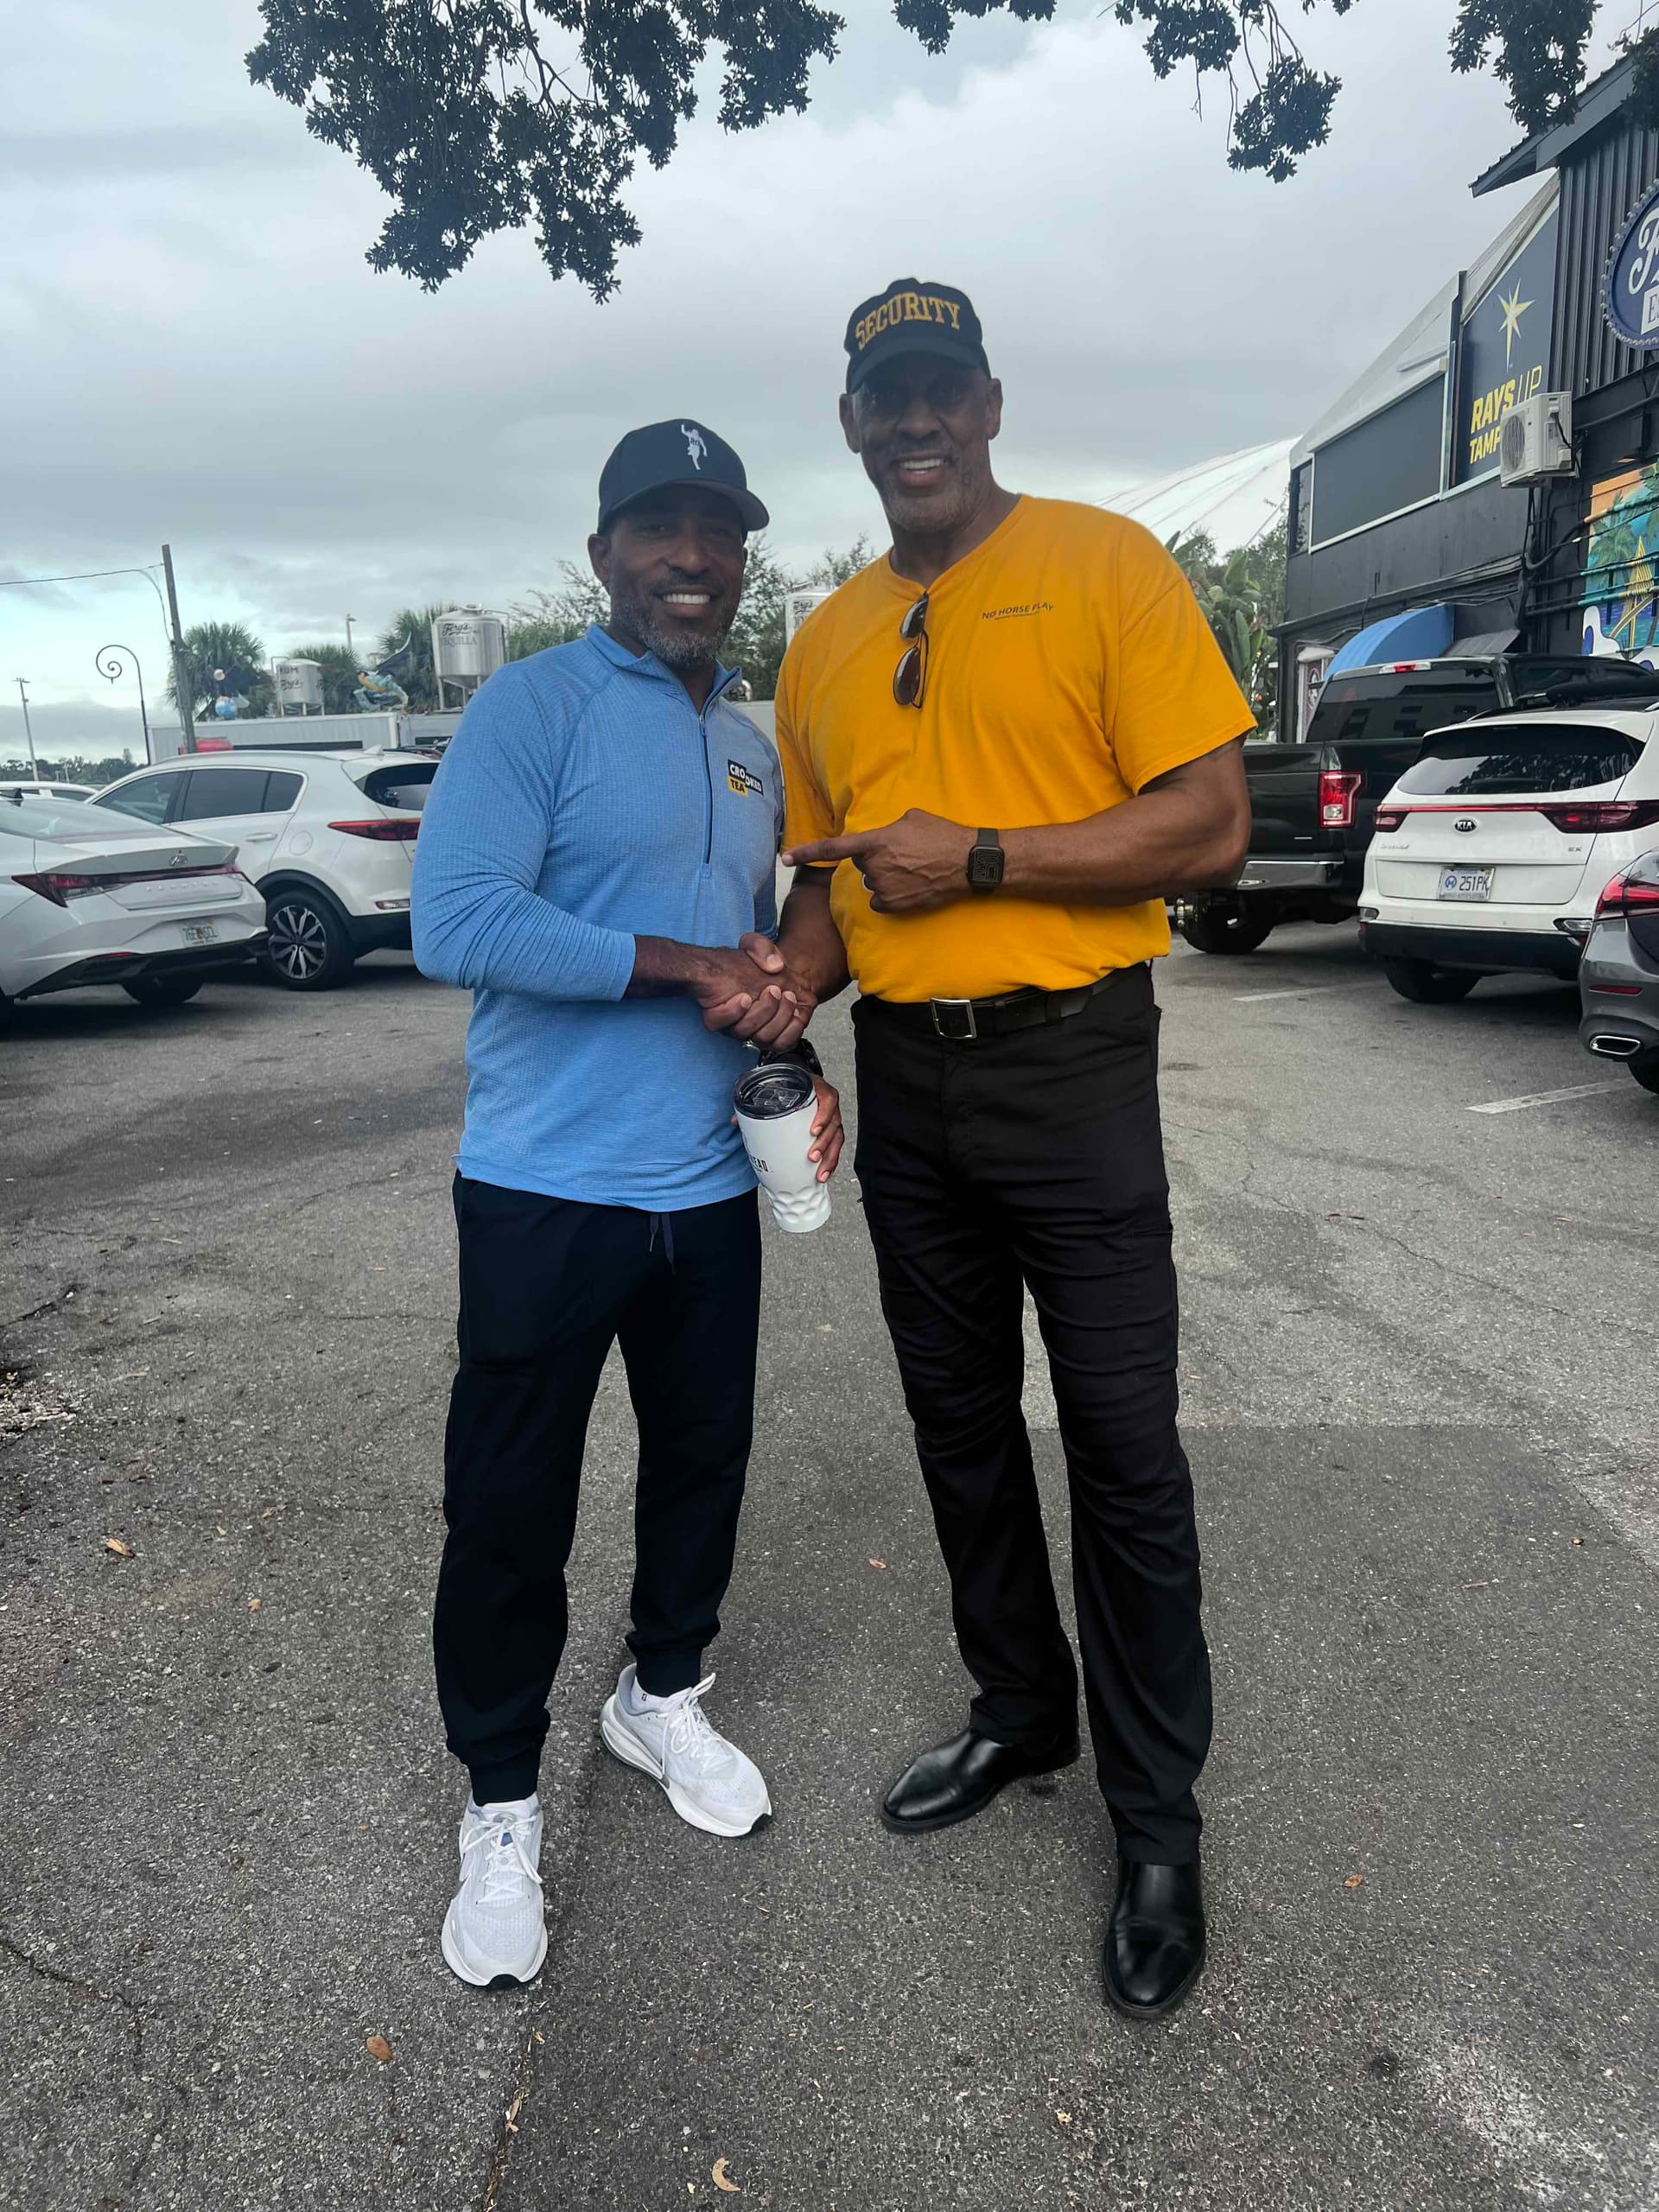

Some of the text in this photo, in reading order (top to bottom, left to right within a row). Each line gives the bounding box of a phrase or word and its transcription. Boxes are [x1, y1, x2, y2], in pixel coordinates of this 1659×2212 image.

[855, 292, 960, 351] SECURITY
[1471, 379, 1516, 434] RAYS
[1470, 426, 1501, 464] TAMP
[998, 606, 1030, 615] HORSE
[1032, 601, 1053, 612] PLAY
[730, 778, 746, 793] TEA
[1457, 821, 1473, 830] KIA
